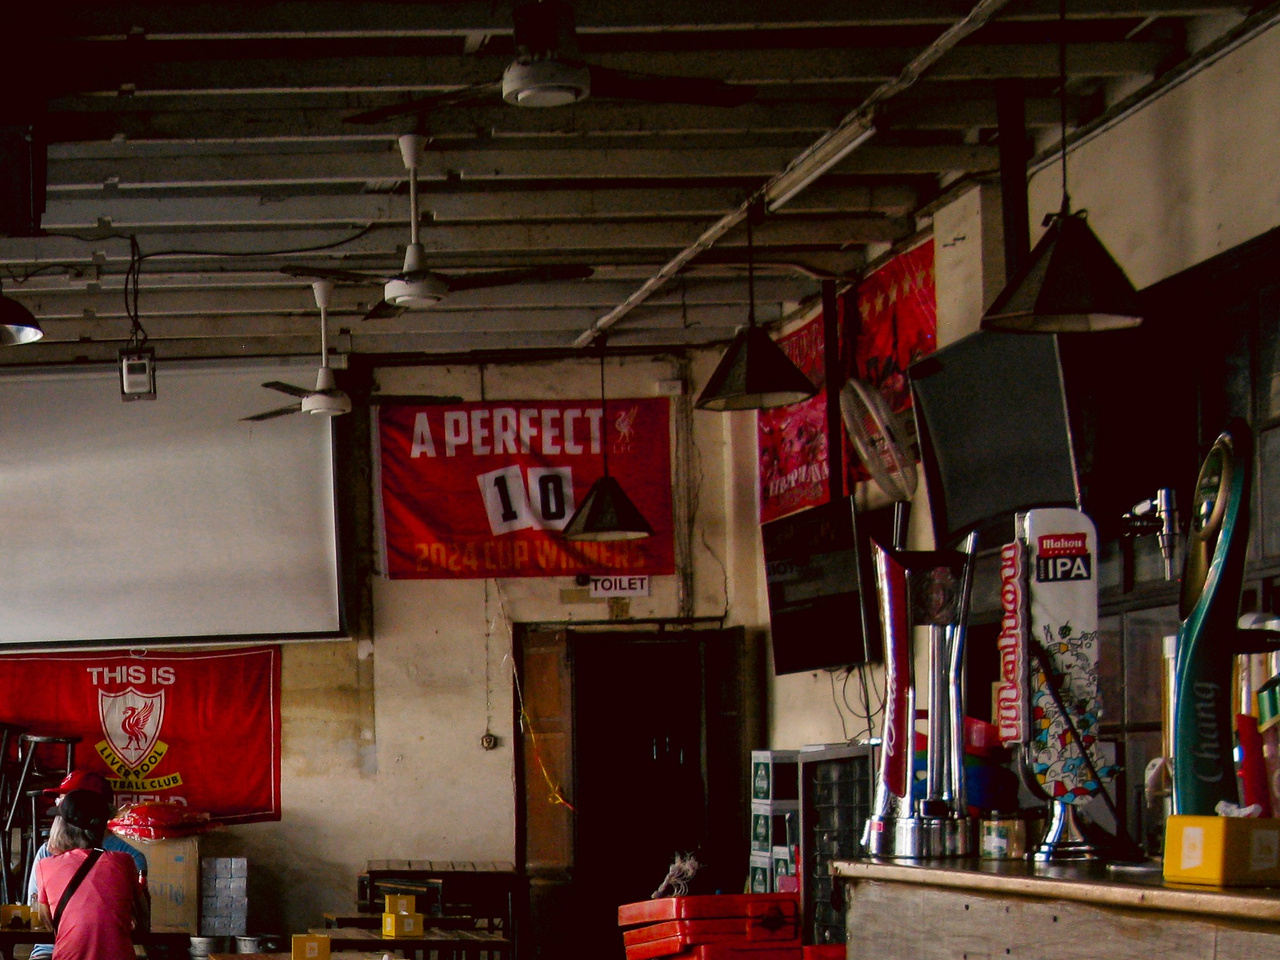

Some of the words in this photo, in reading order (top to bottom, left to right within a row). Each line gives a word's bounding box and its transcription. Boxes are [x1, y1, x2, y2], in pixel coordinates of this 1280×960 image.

[410, 411, 437, 459] A
[444, 406, 604, 458] PERFECT
[493, 474, 566, 523] 10
[414, 542, 479, 572] 2024
[484, 539, 529, 571] CUP
[535, 538, 646, 570] WINNERS
[1042, 538, 1083, 549] Mahou
[1047, 557, 1089, 580] IPA
[591, 577, 647, 592] TOILET
[86, 665, 147, 686] THIS
[151, 666, 177, 686] IS
[1191, 680, 1224, 784] Chang
[99, 745, 164, 780] LIVERPOOL
[110, 780, 147, 790] TBALL
[150, 775, 179, 789] CLUB
